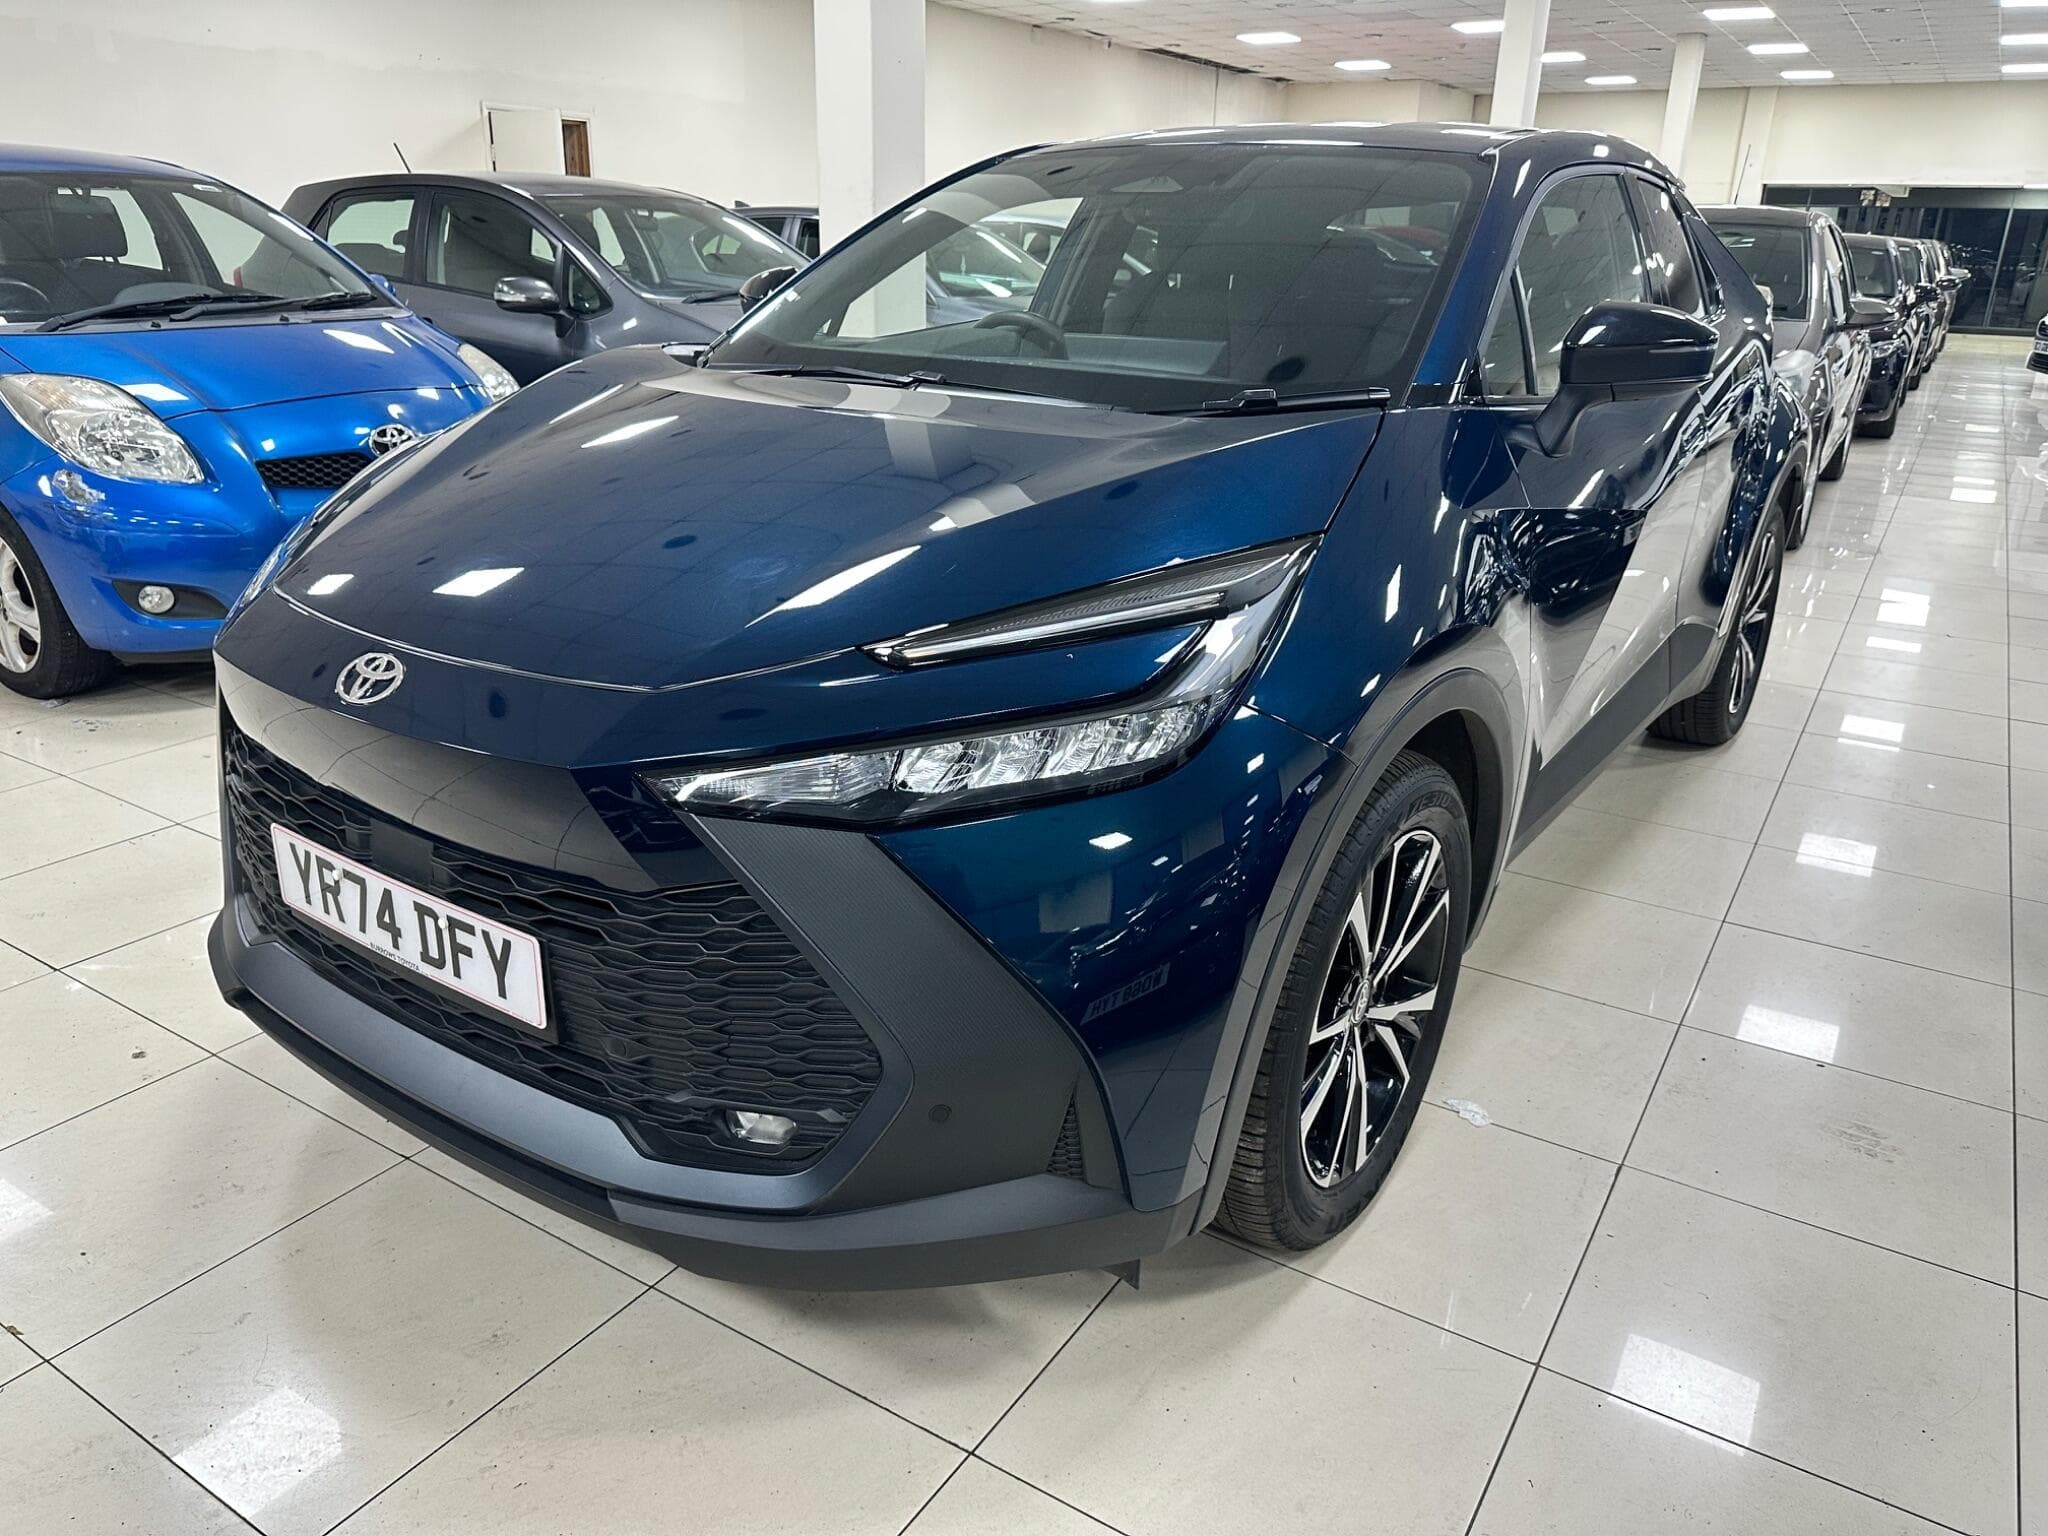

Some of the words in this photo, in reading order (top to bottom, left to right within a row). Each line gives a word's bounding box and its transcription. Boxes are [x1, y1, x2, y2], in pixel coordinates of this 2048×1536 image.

[289, 843, 402, 950] YR74
[413, 901, 511, 1000] DFY
[369, 942, 396, 960] BURROWS
[397, 955, 420, 971] TOYOTA
